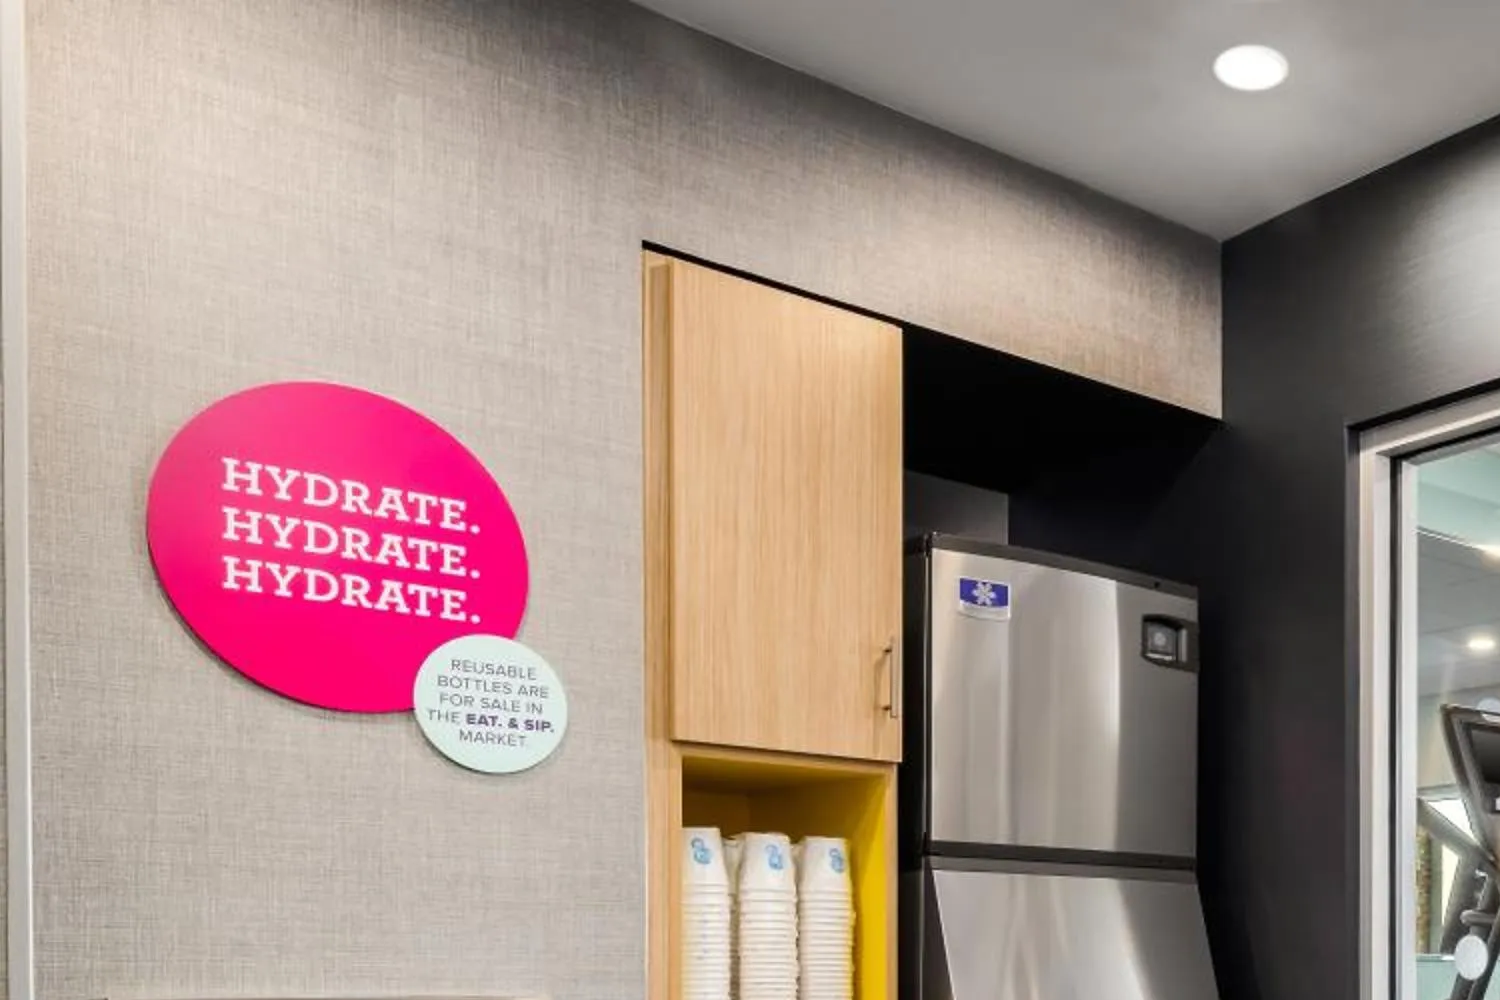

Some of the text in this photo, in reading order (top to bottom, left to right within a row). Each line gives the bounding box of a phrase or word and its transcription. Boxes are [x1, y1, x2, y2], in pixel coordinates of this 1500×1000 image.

[221, 457, 480, 534] HYDRATE.
[221, 506, 480, 579] HYDRATE.
[221, 555, 480, 624] HYDRATE.
[451, 659, 537, 680] REUSABLE
[437, 675, 549, 699] BOTTLES ARE
[439, 692, 543, 715] FOR SALE IN
[427, 708, 555, 733] THE EAT. & SIP.
